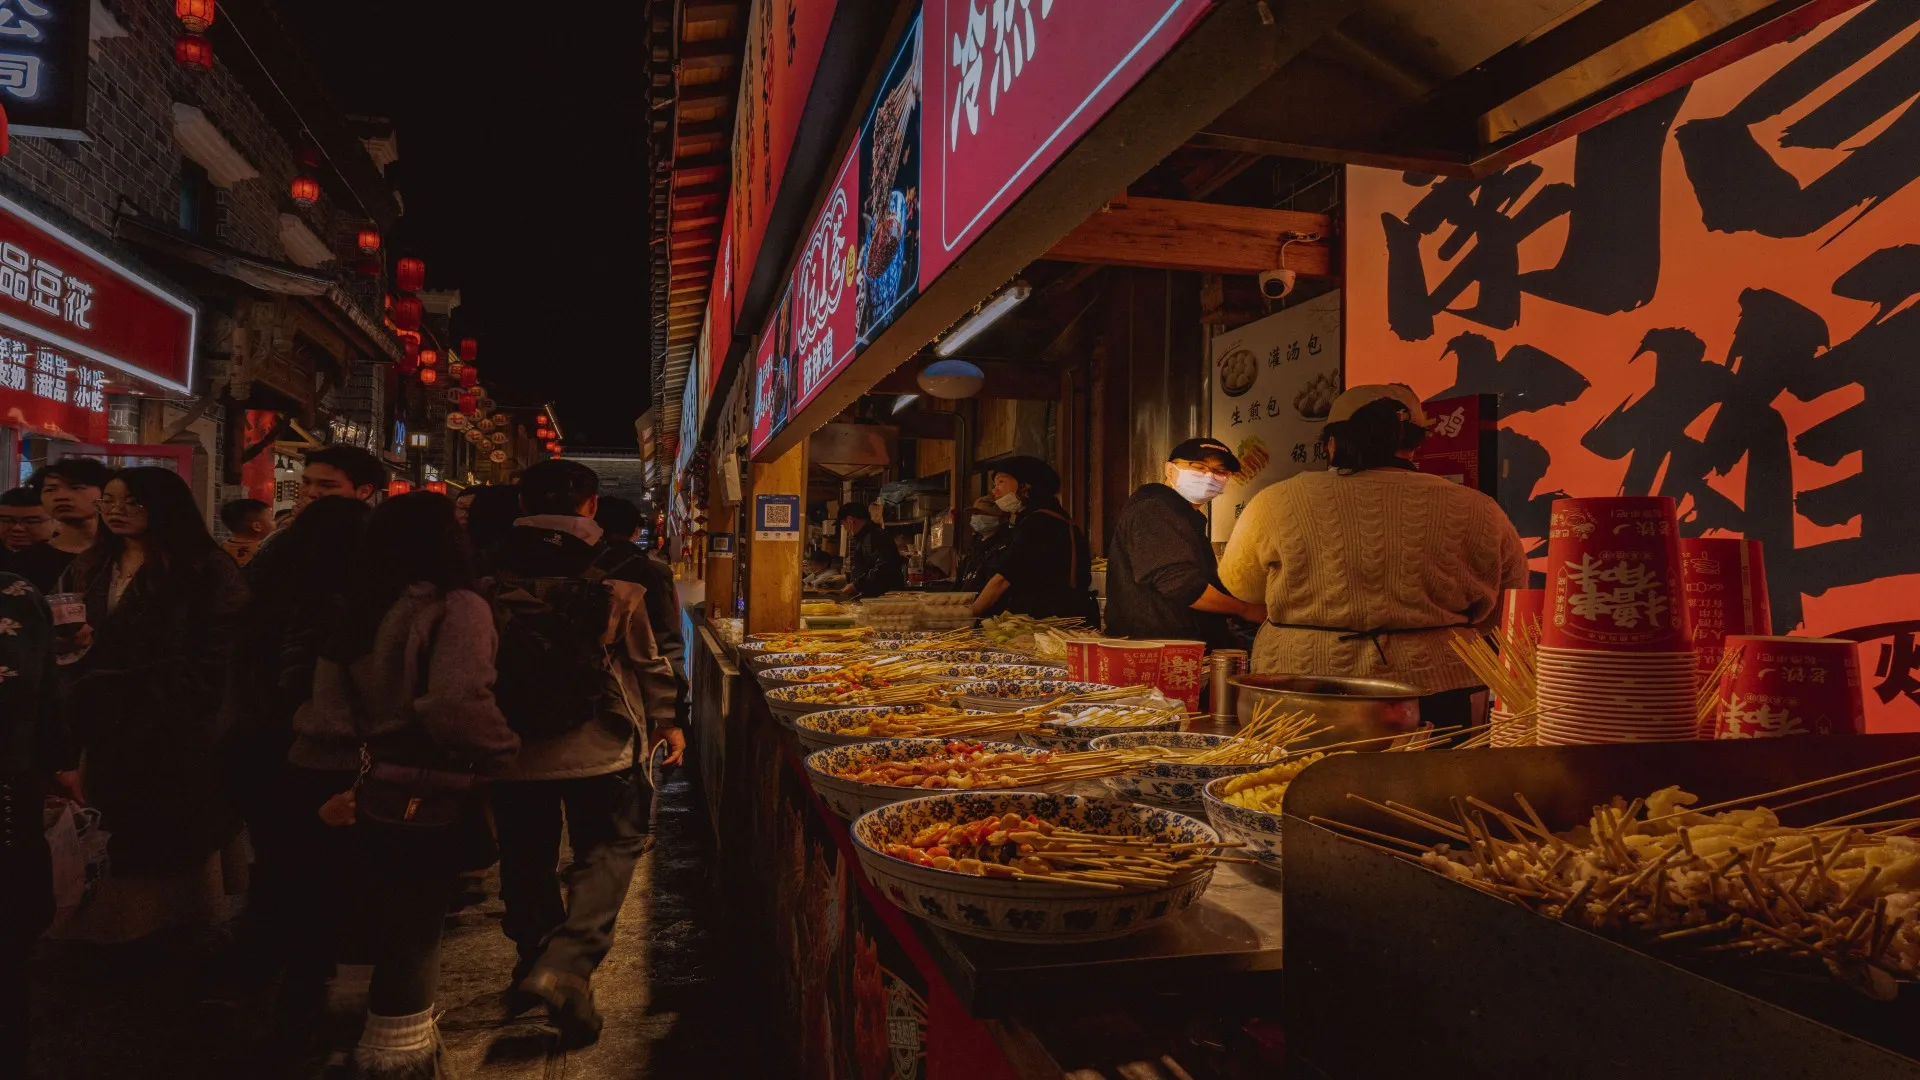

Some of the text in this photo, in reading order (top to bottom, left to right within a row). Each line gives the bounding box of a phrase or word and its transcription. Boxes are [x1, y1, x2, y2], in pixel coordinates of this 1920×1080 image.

[0, 242, 93, 329] 品豆花
[1268, 334, 1321, 368] 灌汤包
[74, 386, 104, 412] 小吃
[1231, 396, 1280, 427] 生煎包
[1423, 406, 1465, 438] 鸡
[1635, 521, 1671, 536] 老铁
[1565, 552, 1663, 595] 有味
[1569, 587, 1668, 628] 撸串
[1781, 666, 1828, 683] 老铁
